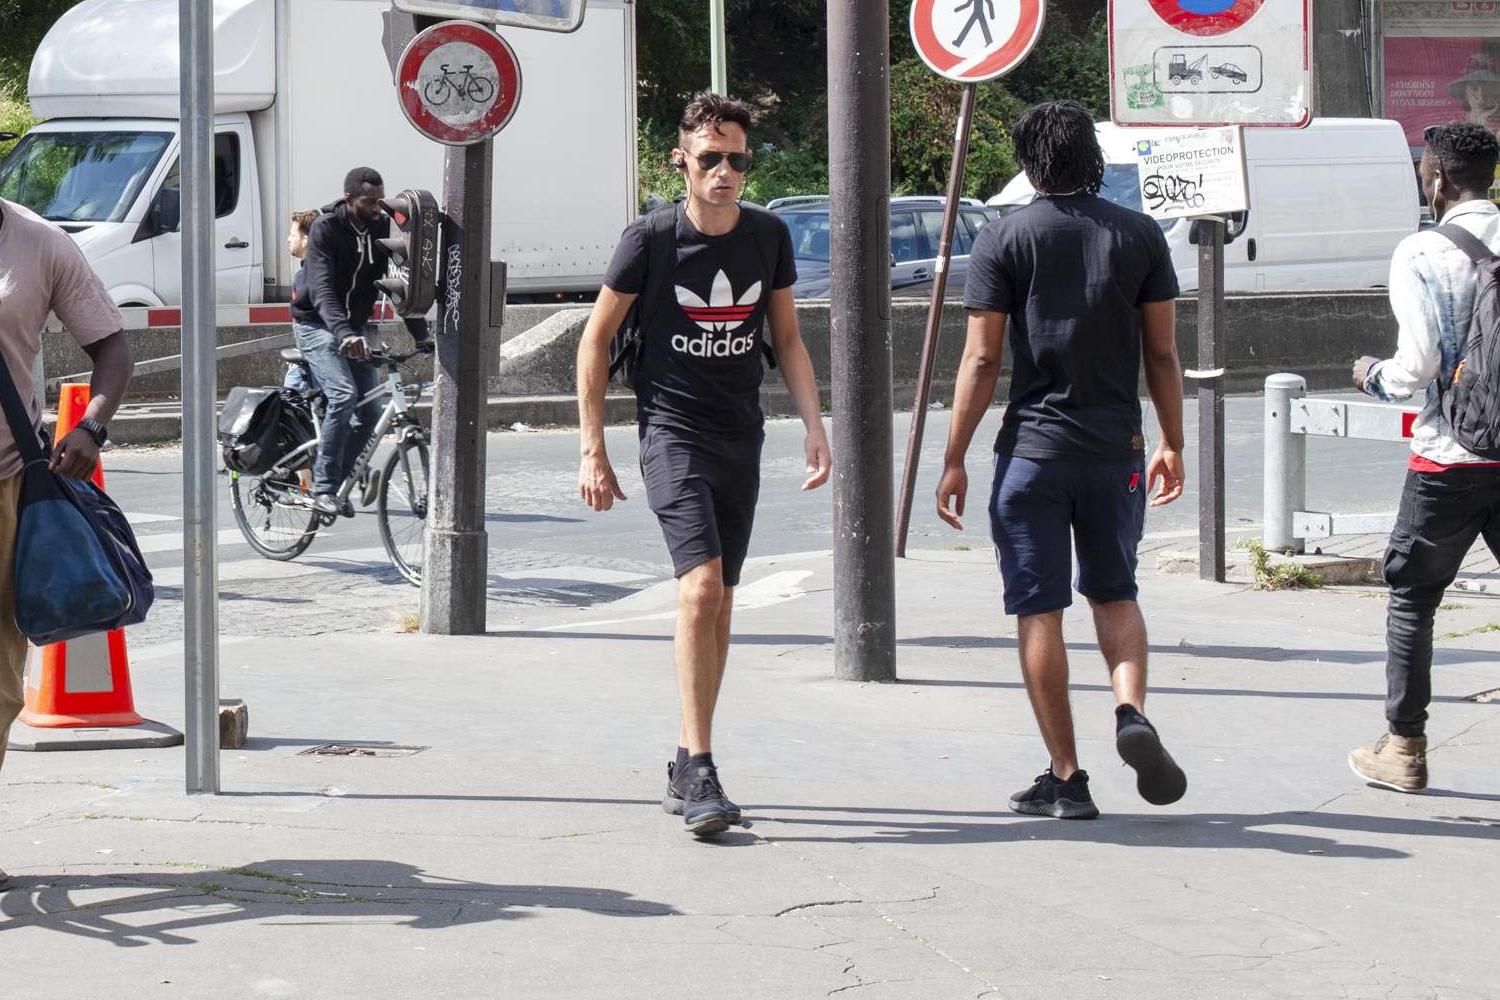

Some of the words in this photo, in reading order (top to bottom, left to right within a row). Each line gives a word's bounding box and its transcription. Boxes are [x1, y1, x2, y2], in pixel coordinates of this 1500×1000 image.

[1395, 80, 1435, 88] L'HÉROÏNE
[1144, 146, 1234, 164] VIDEOPROTECTION
[671, 332, 754, 357] adidas
